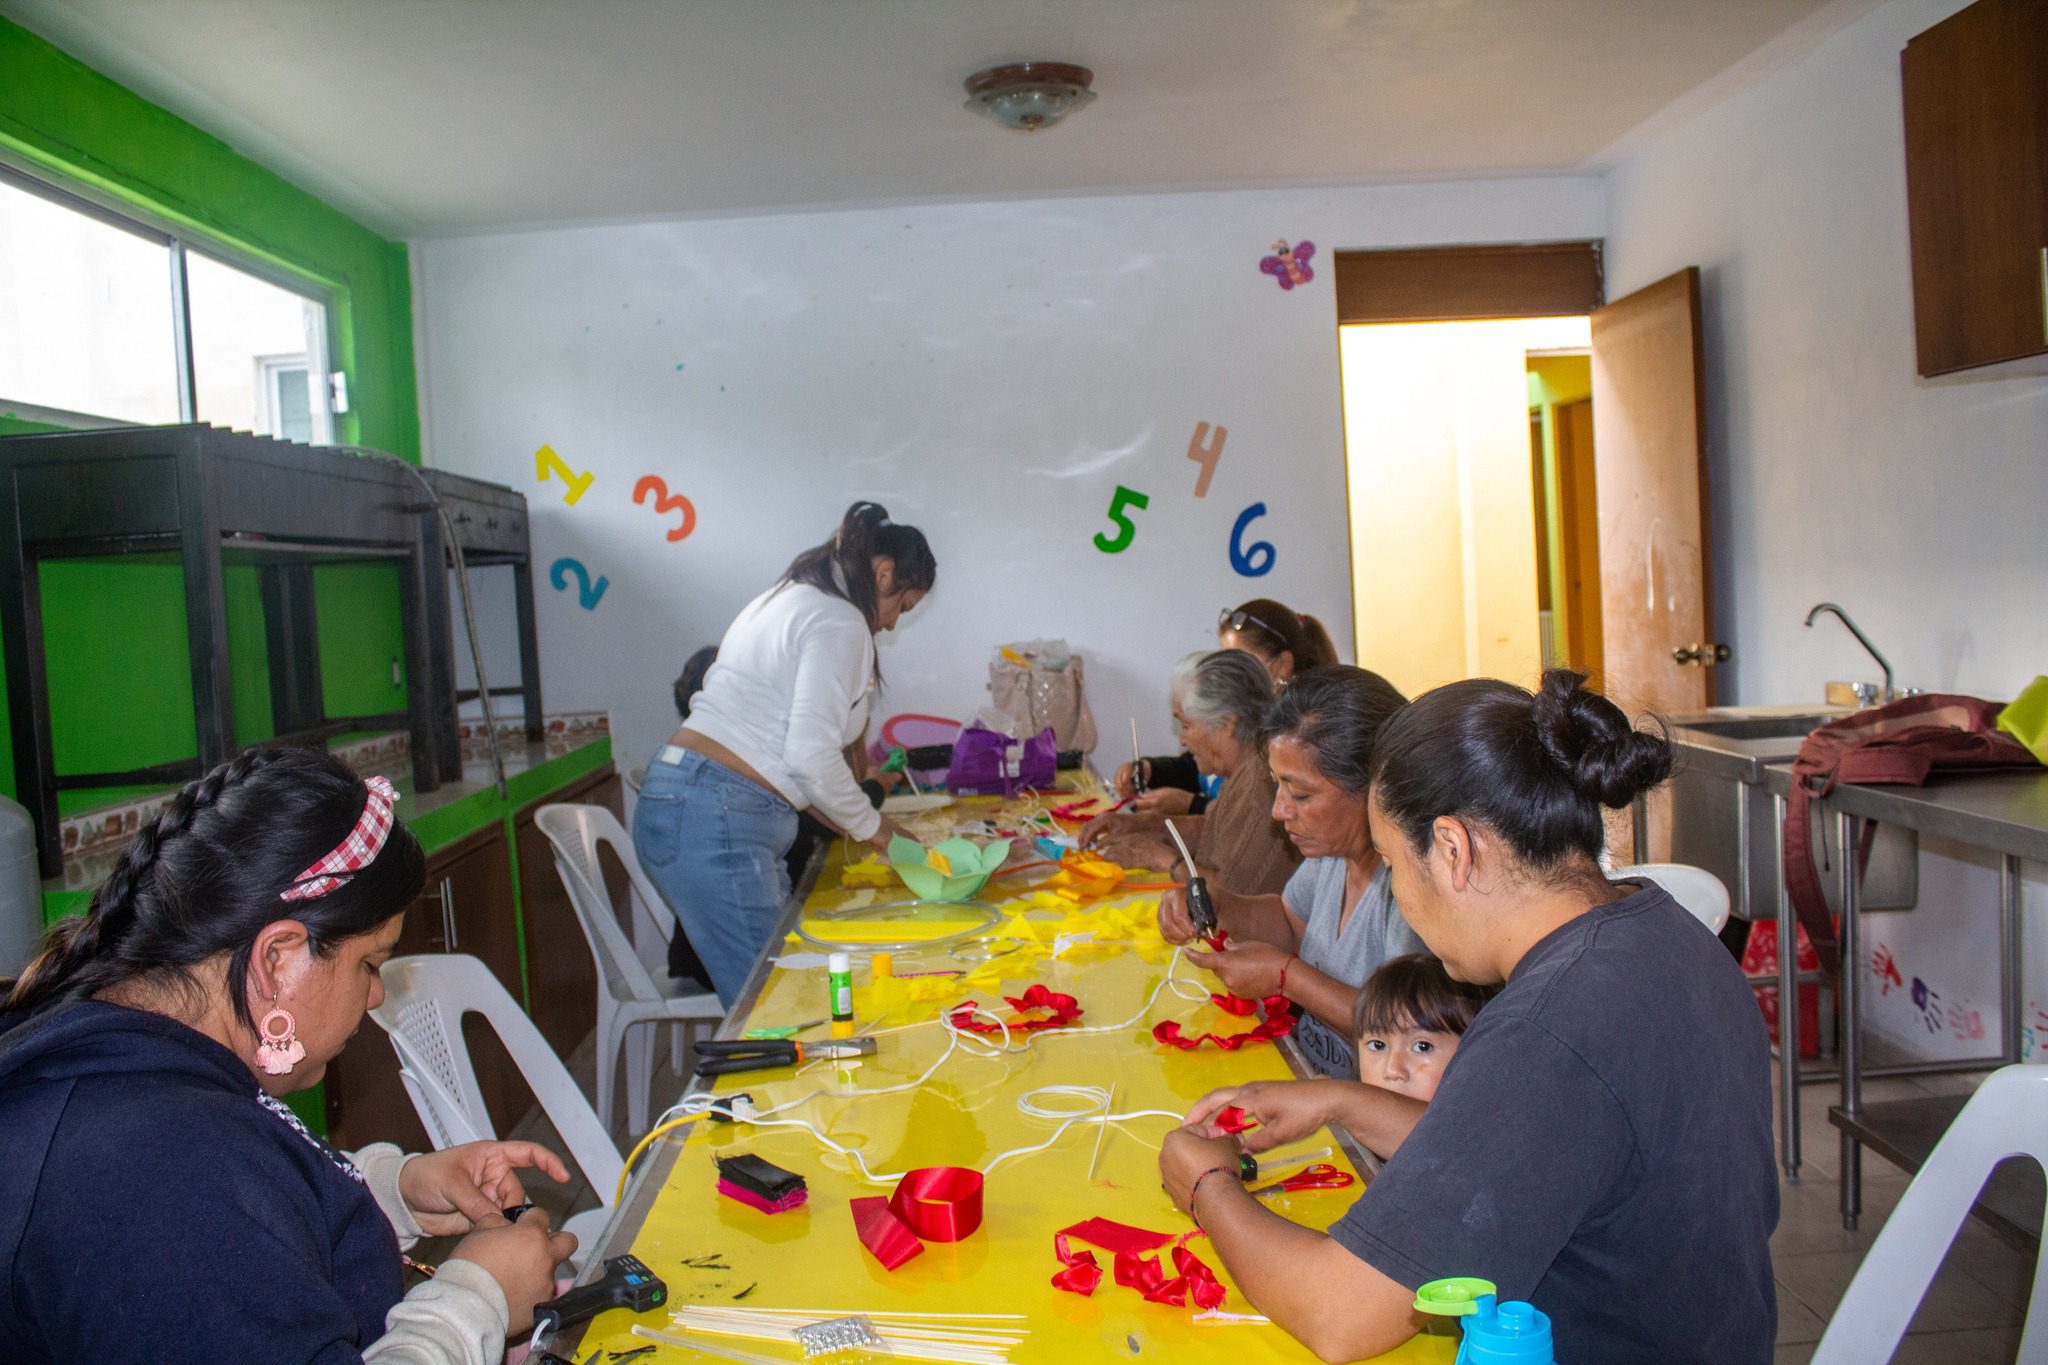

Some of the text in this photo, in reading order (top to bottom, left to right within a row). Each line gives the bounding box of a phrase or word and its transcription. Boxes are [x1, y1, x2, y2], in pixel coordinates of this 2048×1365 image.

[536, 444, 595, 507] 1
[1187, 422, 1228, 498] 4
[632, 474, 696, 543] 3
[1093, 485, 1150, 554] 5
[1229, 501, 1277, 578] 6
[551, 558, 609, 611] 2
